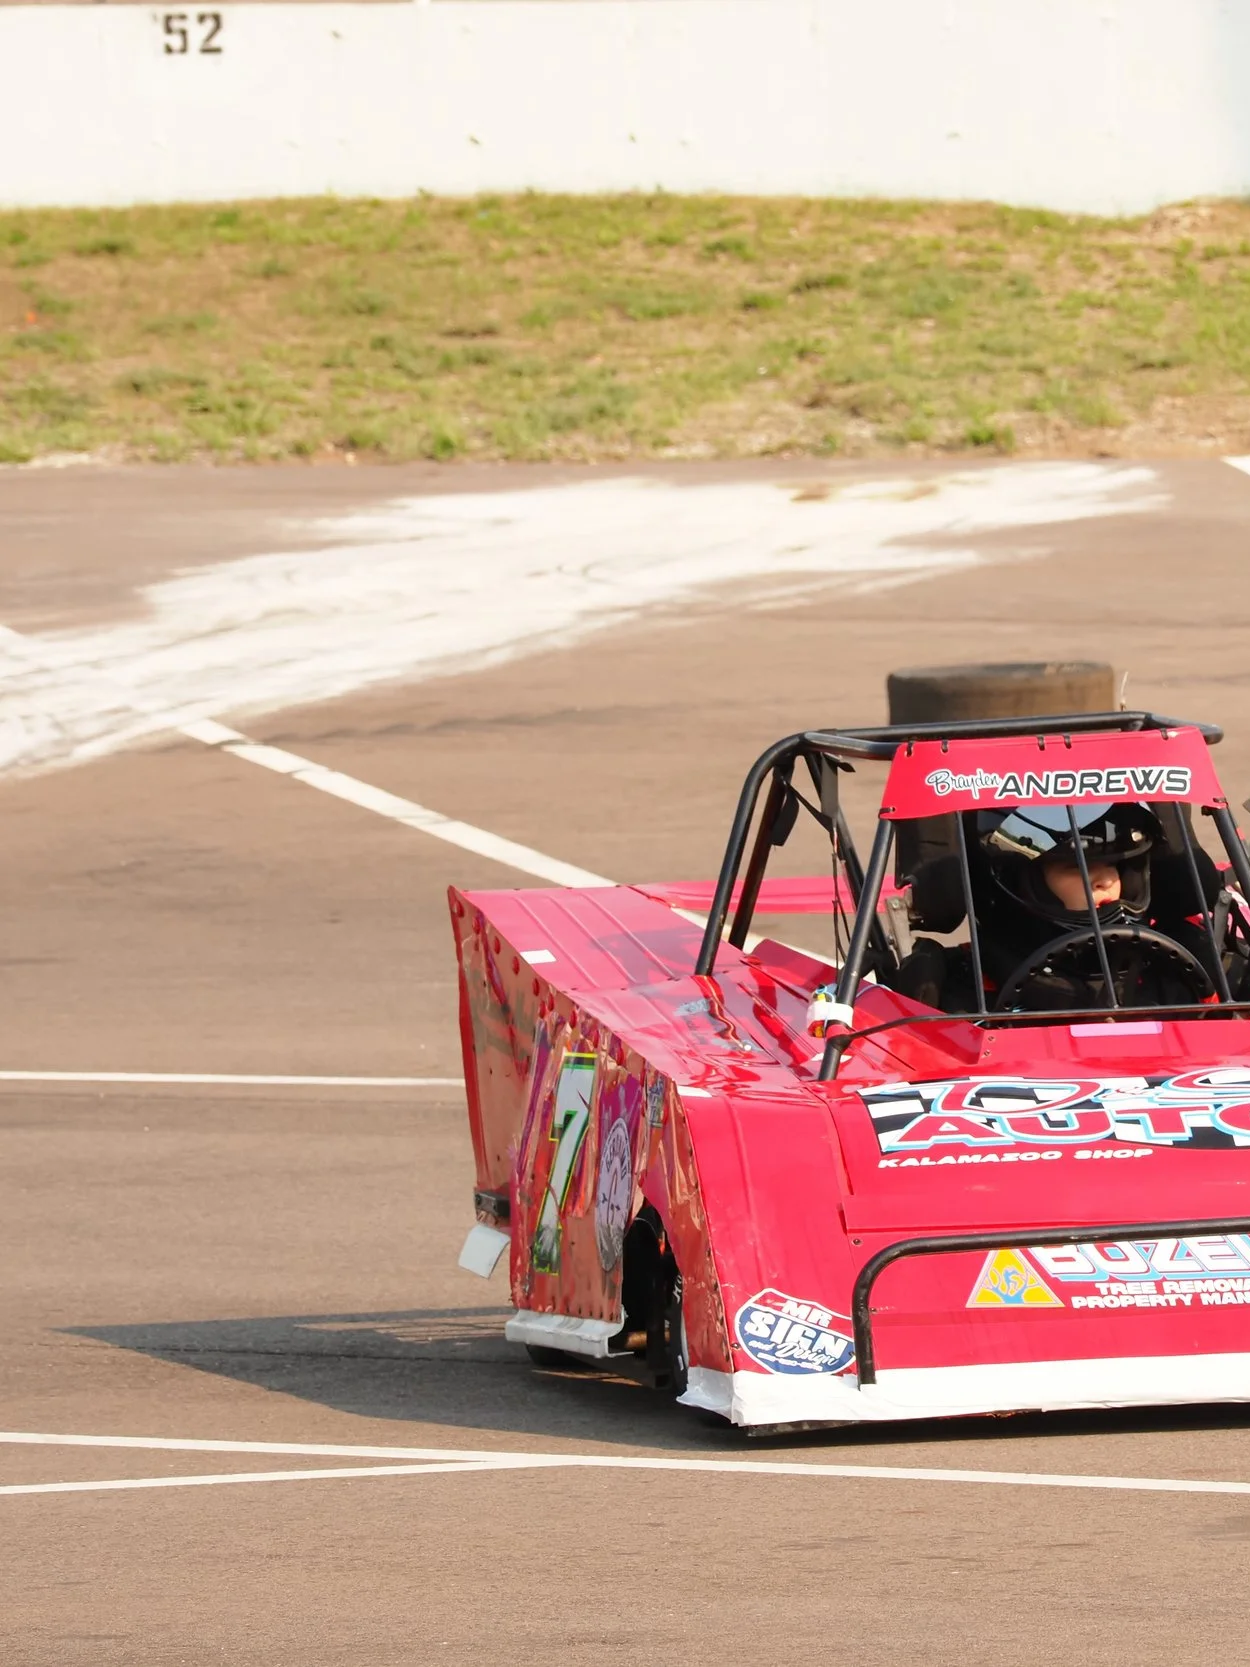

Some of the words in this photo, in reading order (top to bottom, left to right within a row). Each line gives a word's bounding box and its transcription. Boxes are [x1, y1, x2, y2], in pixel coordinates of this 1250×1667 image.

[163, 12, 223, 55] 52
[926, 768, 1000, 800] Brayden
[997, 768, 1191, 799] ANDREWS
[534, 1051, 598, 1276] 7
[878, 1150, 1063, 1169] KALAMAZOO
[1073, 1148, 1154, 1160] SHOP
[1071, 1293, 1193, 1309] PROPERTY
[1095, 1281, 1158, 1296] TREE
[743, 1310, 849, 1360] SIGN
[774, 1341, 838, 1366] Design
